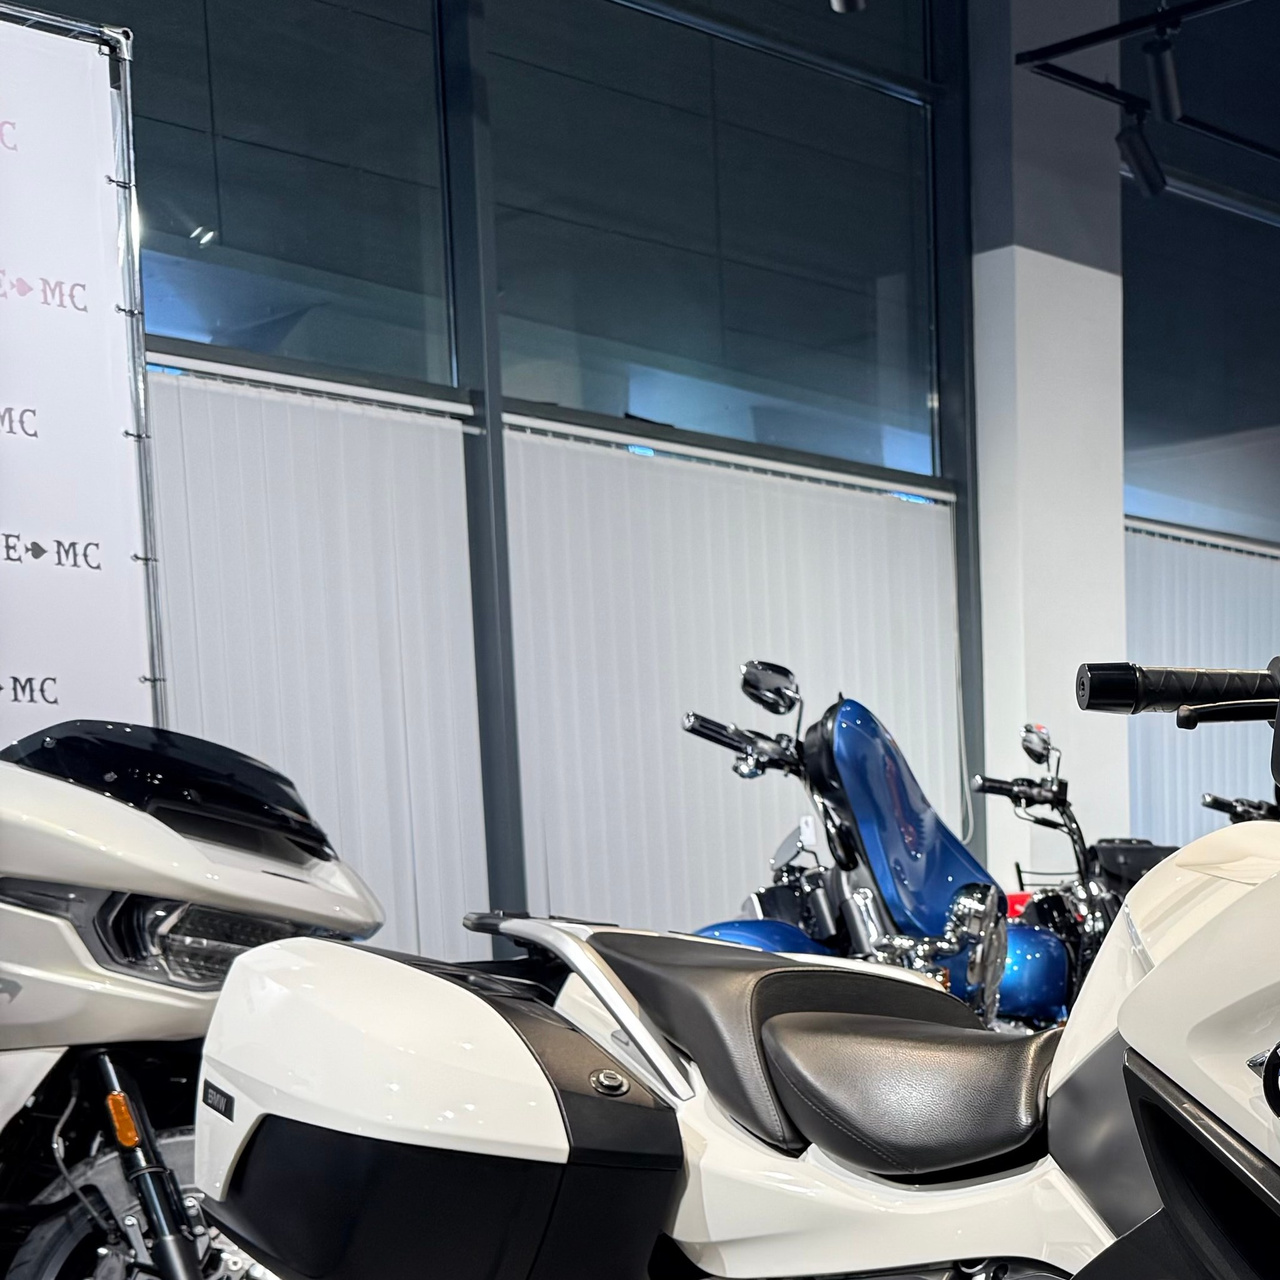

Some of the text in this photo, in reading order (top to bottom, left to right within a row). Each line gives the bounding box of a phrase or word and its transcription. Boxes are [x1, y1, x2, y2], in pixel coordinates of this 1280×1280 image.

[39, 277, 88, 313] MC
[53, 540, 102, 570] MC
[9, 676, 59, 705] MC
